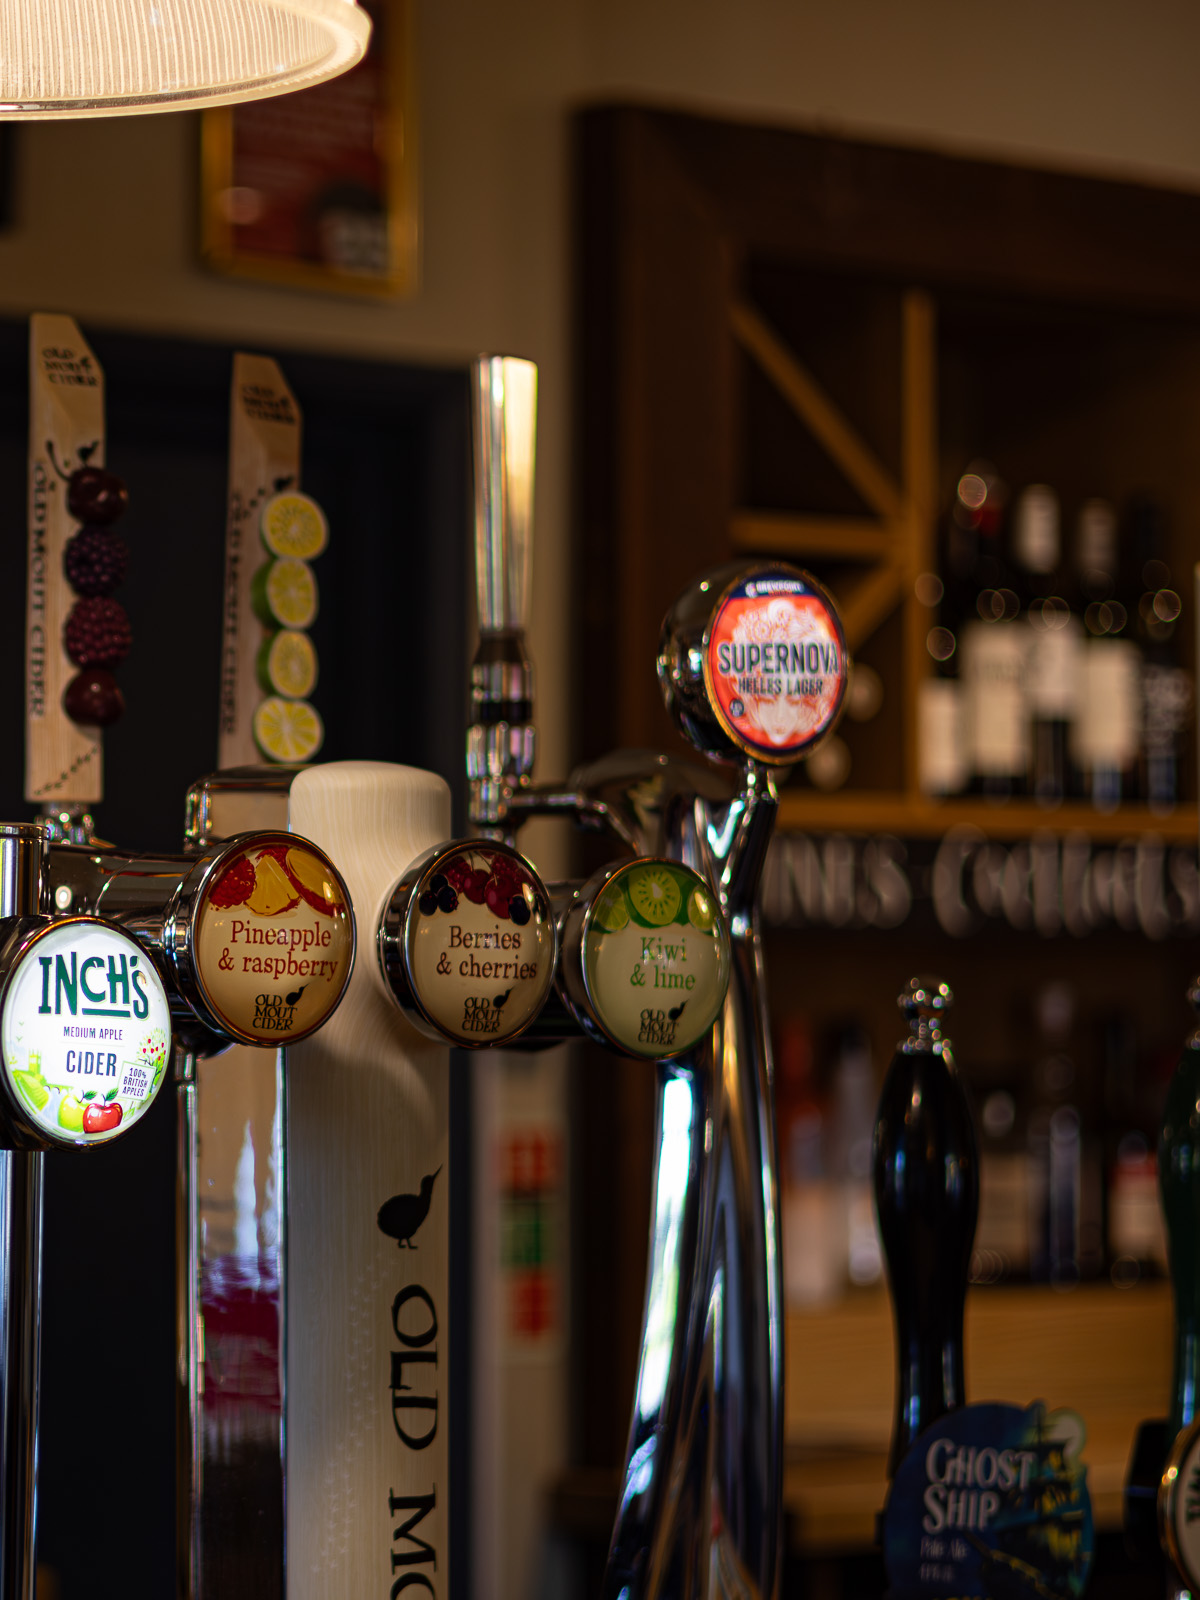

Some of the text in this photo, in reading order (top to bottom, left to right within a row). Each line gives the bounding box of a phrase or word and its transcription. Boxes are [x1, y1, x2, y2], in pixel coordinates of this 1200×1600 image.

[32, 465, 51, 719] OLD MOUT CIDER
[718, 643, 839, 674] SUPERNOVA
[738, 678, 822, 695] HELLES LAGER
[230, 920, 332, 951] Pineapple
[448, 924, 521, 949] Berries
[640, 937, 687, 962] Kiwi
[218, 947, 338, 982] & raspberry
[436, 952, 537, 980] & cherries
[38, 951, 149, 1019] INCH'S
[630, 964, 695, 990] & lime
[255, 994, 283, 1007] OLD
[464, 997, 490, 1010] OLD
[254, 1006, 298, 1019] MOUT
[464, 1008, 503, 1021] MOUT
[640, 1008, 665, 1021] OLD
[252, 1017, 294, 1031] CIDER
[462, 1019, 500, 1032] CIDER
[640, 1020, 679, 1033] MOUT
[63, 1026, 123, 1041] MEDIUM APPLE
[638, 1031, 675, 1045] CIDER
[66, 1050, 117, 1077] CIDER
[129, 1067, 147, 1079] 100%
[123, 1076, 148, 1088] BRITISH
[122, 1086, 144, 1097] APPLES
[389, 1284, 439, 1450] OLD
[926, 1437, 1037, 1490] GHOST
[922, 1483, 1000, 1534] SHIP
